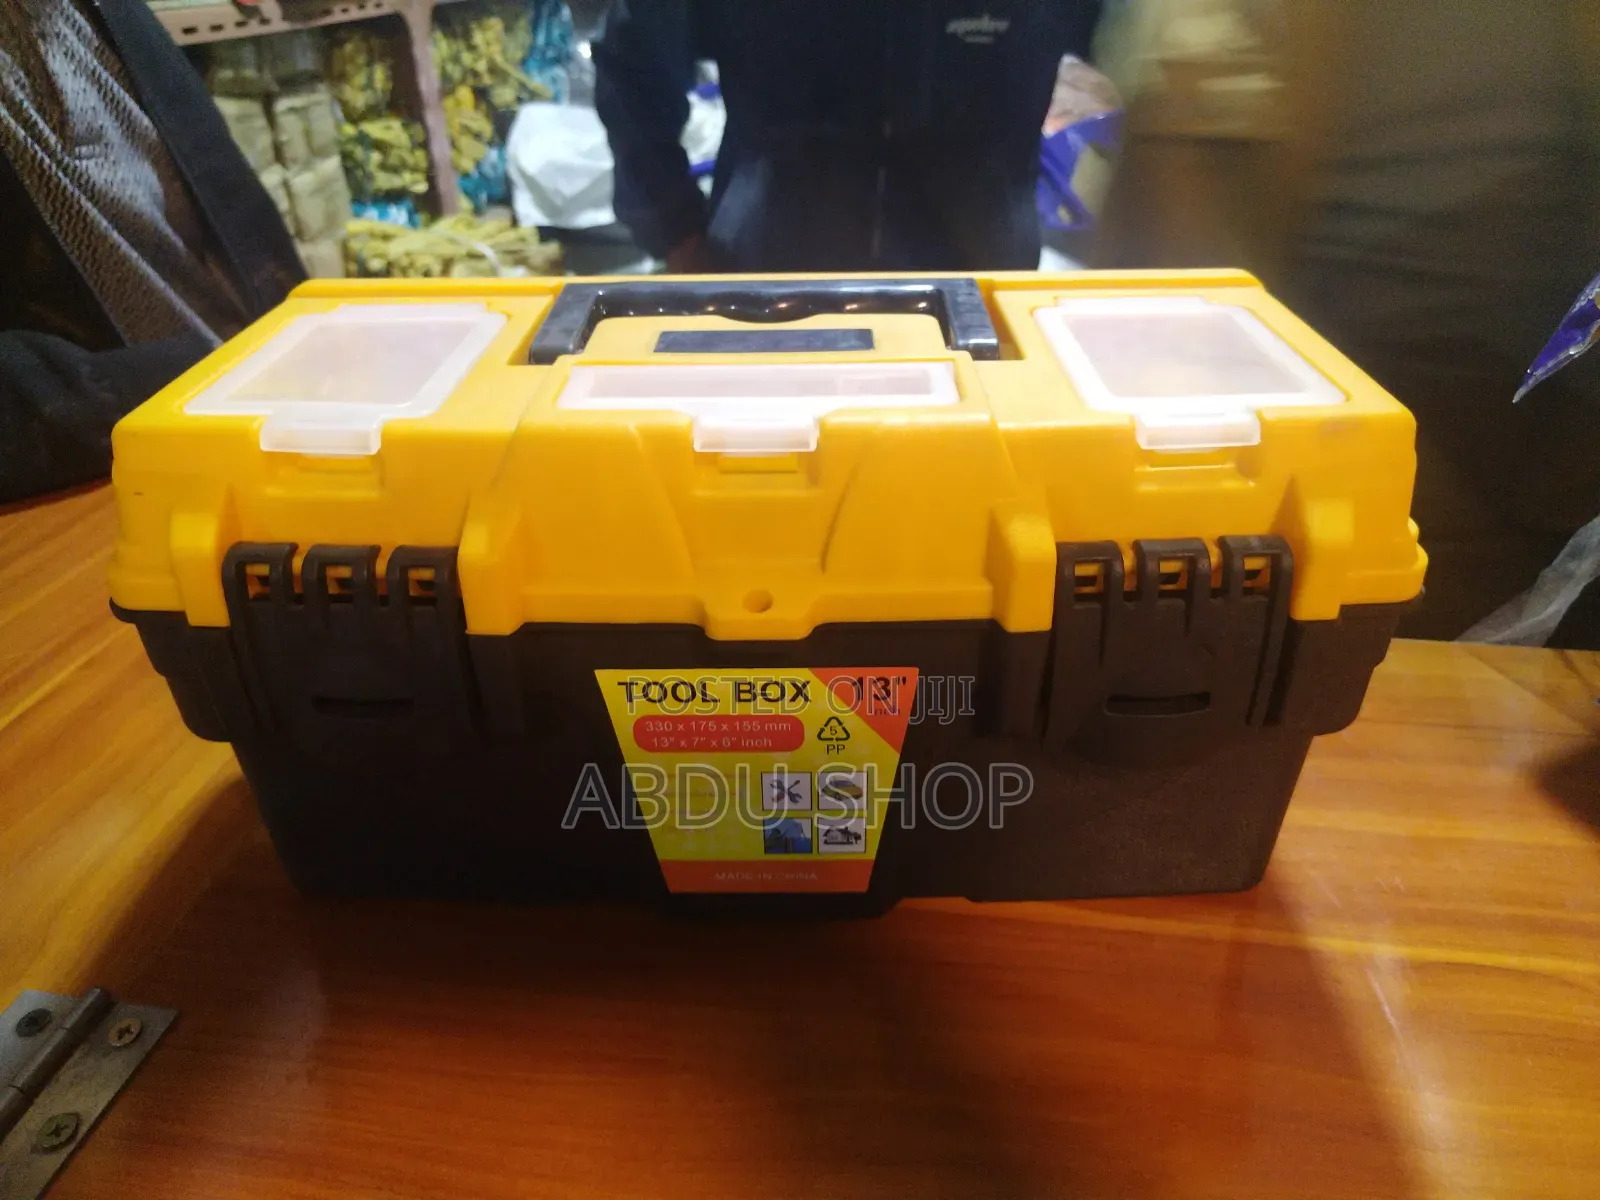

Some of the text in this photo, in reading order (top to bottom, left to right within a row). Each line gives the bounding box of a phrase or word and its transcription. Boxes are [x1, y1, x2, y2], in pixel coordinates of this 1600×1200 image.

[617, 681, 812, 703] TOOL BOX
[851, 677, 907, 701] 13"
[645, 720, 791, 732] 330 x 175 x 155 mm
[651, 736, 772, 748] 13" x 7" x 6" inch
[826, 743, 846, 755] PP
